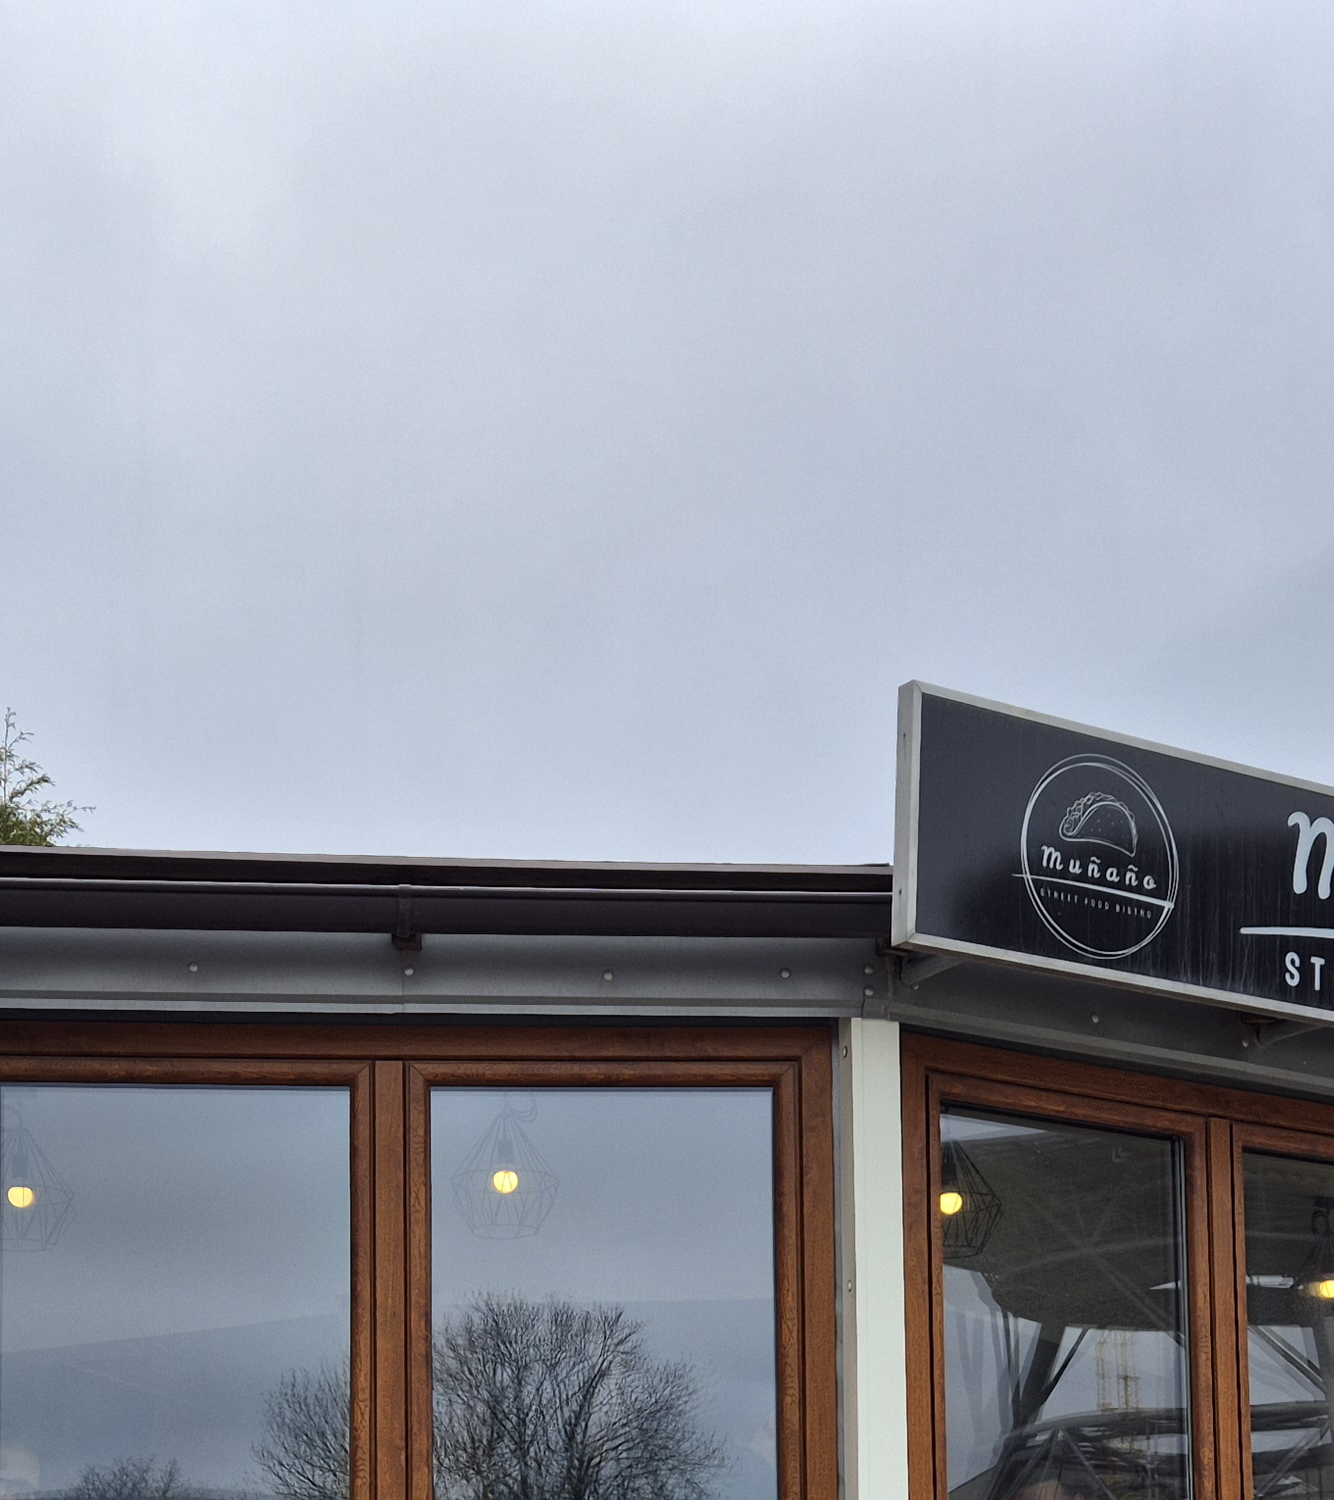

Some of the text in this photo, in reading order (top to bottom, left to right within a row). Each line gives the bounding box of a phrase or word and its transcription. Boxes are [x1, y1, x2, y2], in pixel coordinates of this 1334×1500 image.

[1041, 844, 1157, 890] Muñaño
[1040, 887, 1152, 920] STREET FOOD BISTRO
